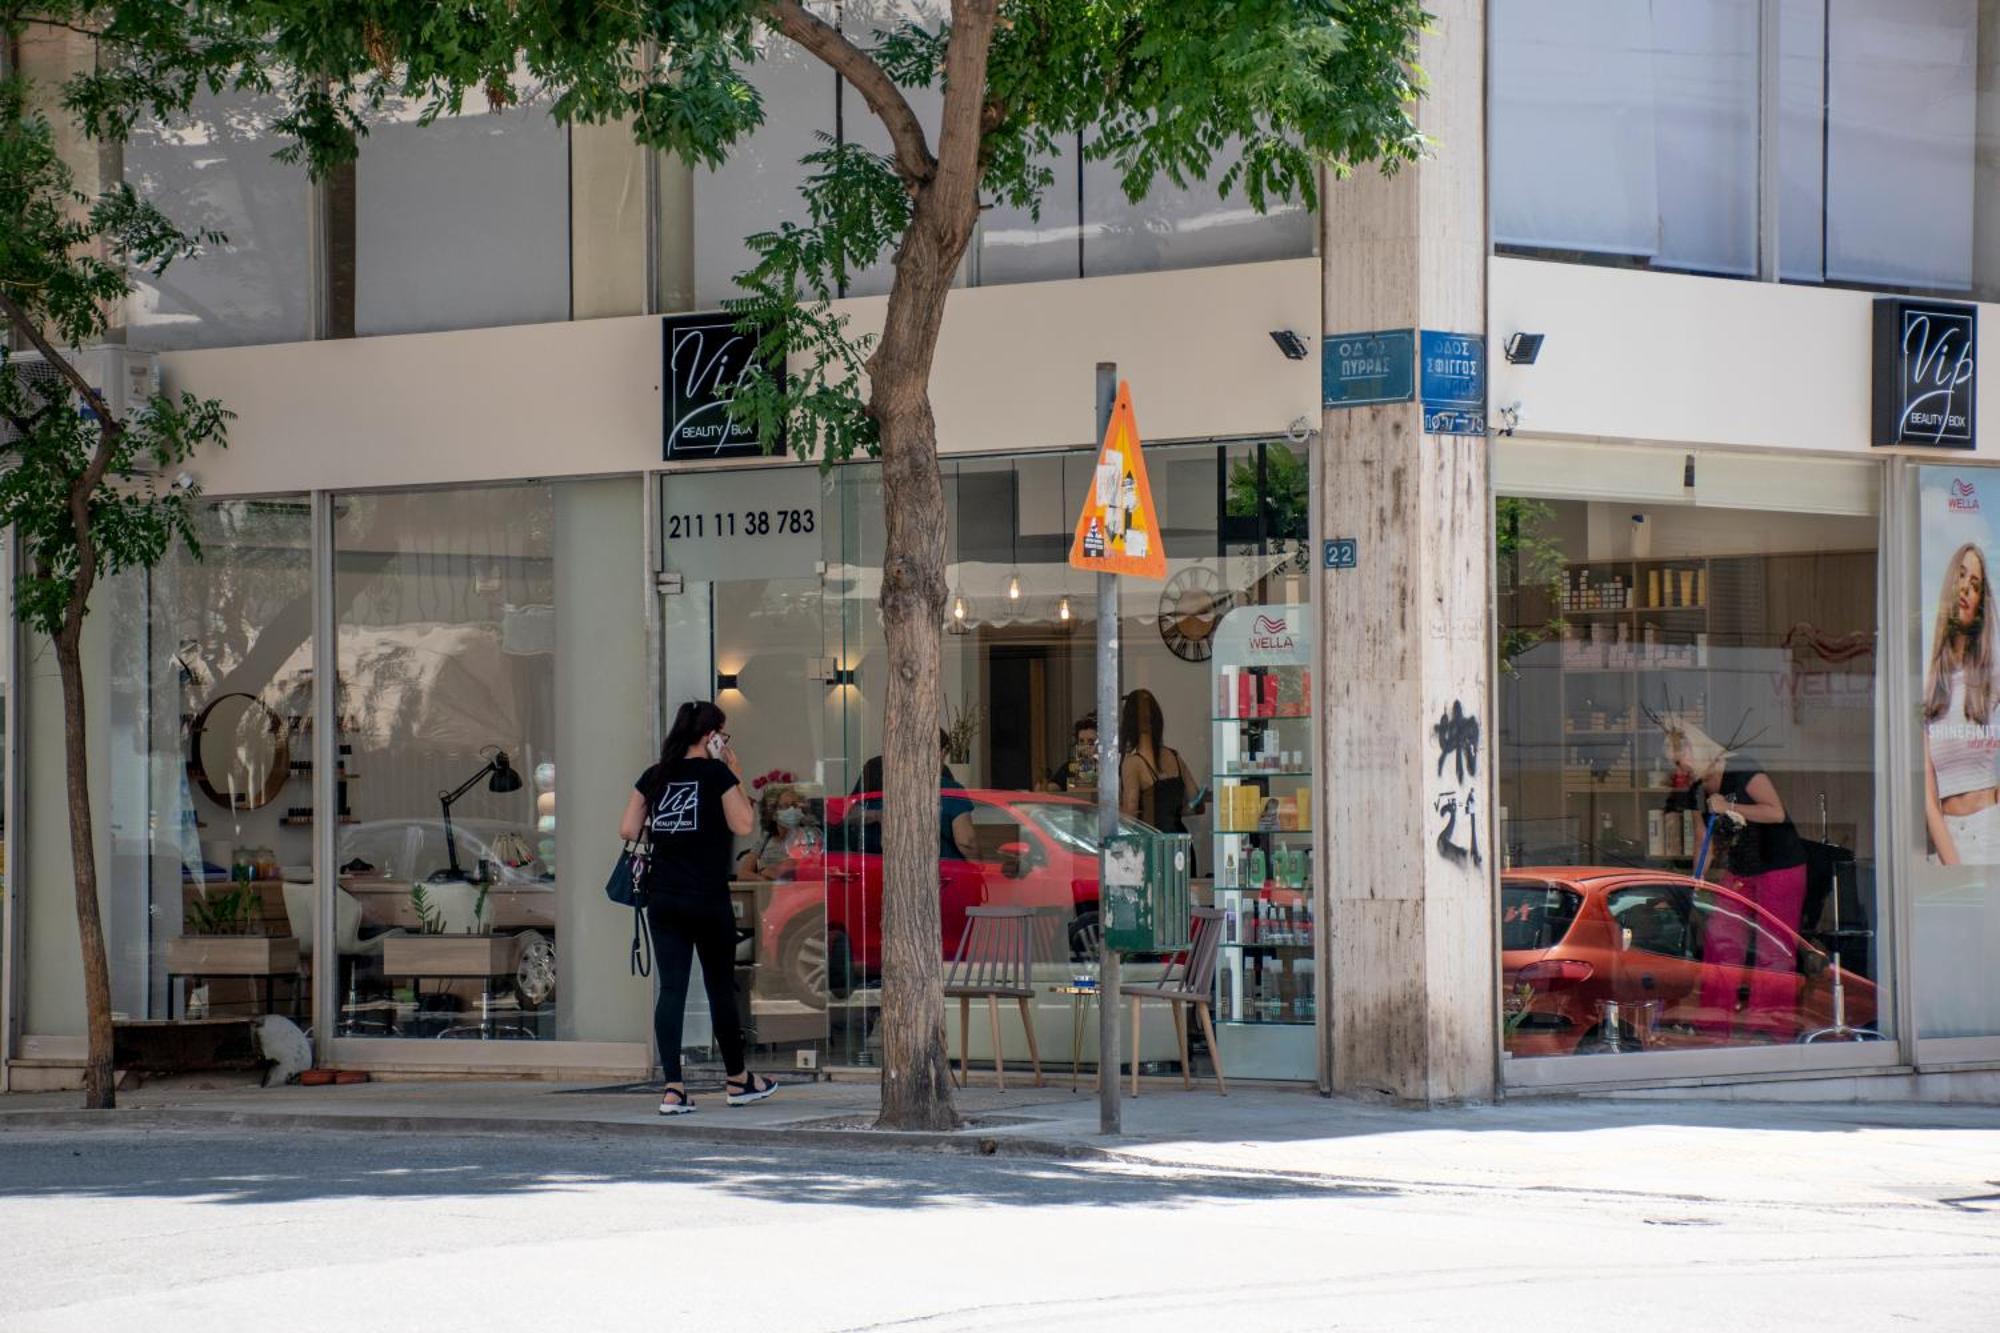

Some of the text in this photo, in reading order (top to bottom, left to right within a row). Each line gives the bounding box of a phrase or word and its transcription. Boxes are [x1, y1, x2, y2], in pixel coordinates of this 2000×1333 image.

[1902, 315, 1973, 444] Vip
[1911, 411, 1966, 428] BEAUTY BOX
[682, 424, 723, 438] BEAUTY
[1948, 498, 1980, 509] WELLA
[669, 509, 815, 539] 211 11 38 783
[1328, 546, 1352, 562] 22
[1249, 636, 1295, 650] WELLA
[1769, 671, 1873, 698] WELL
